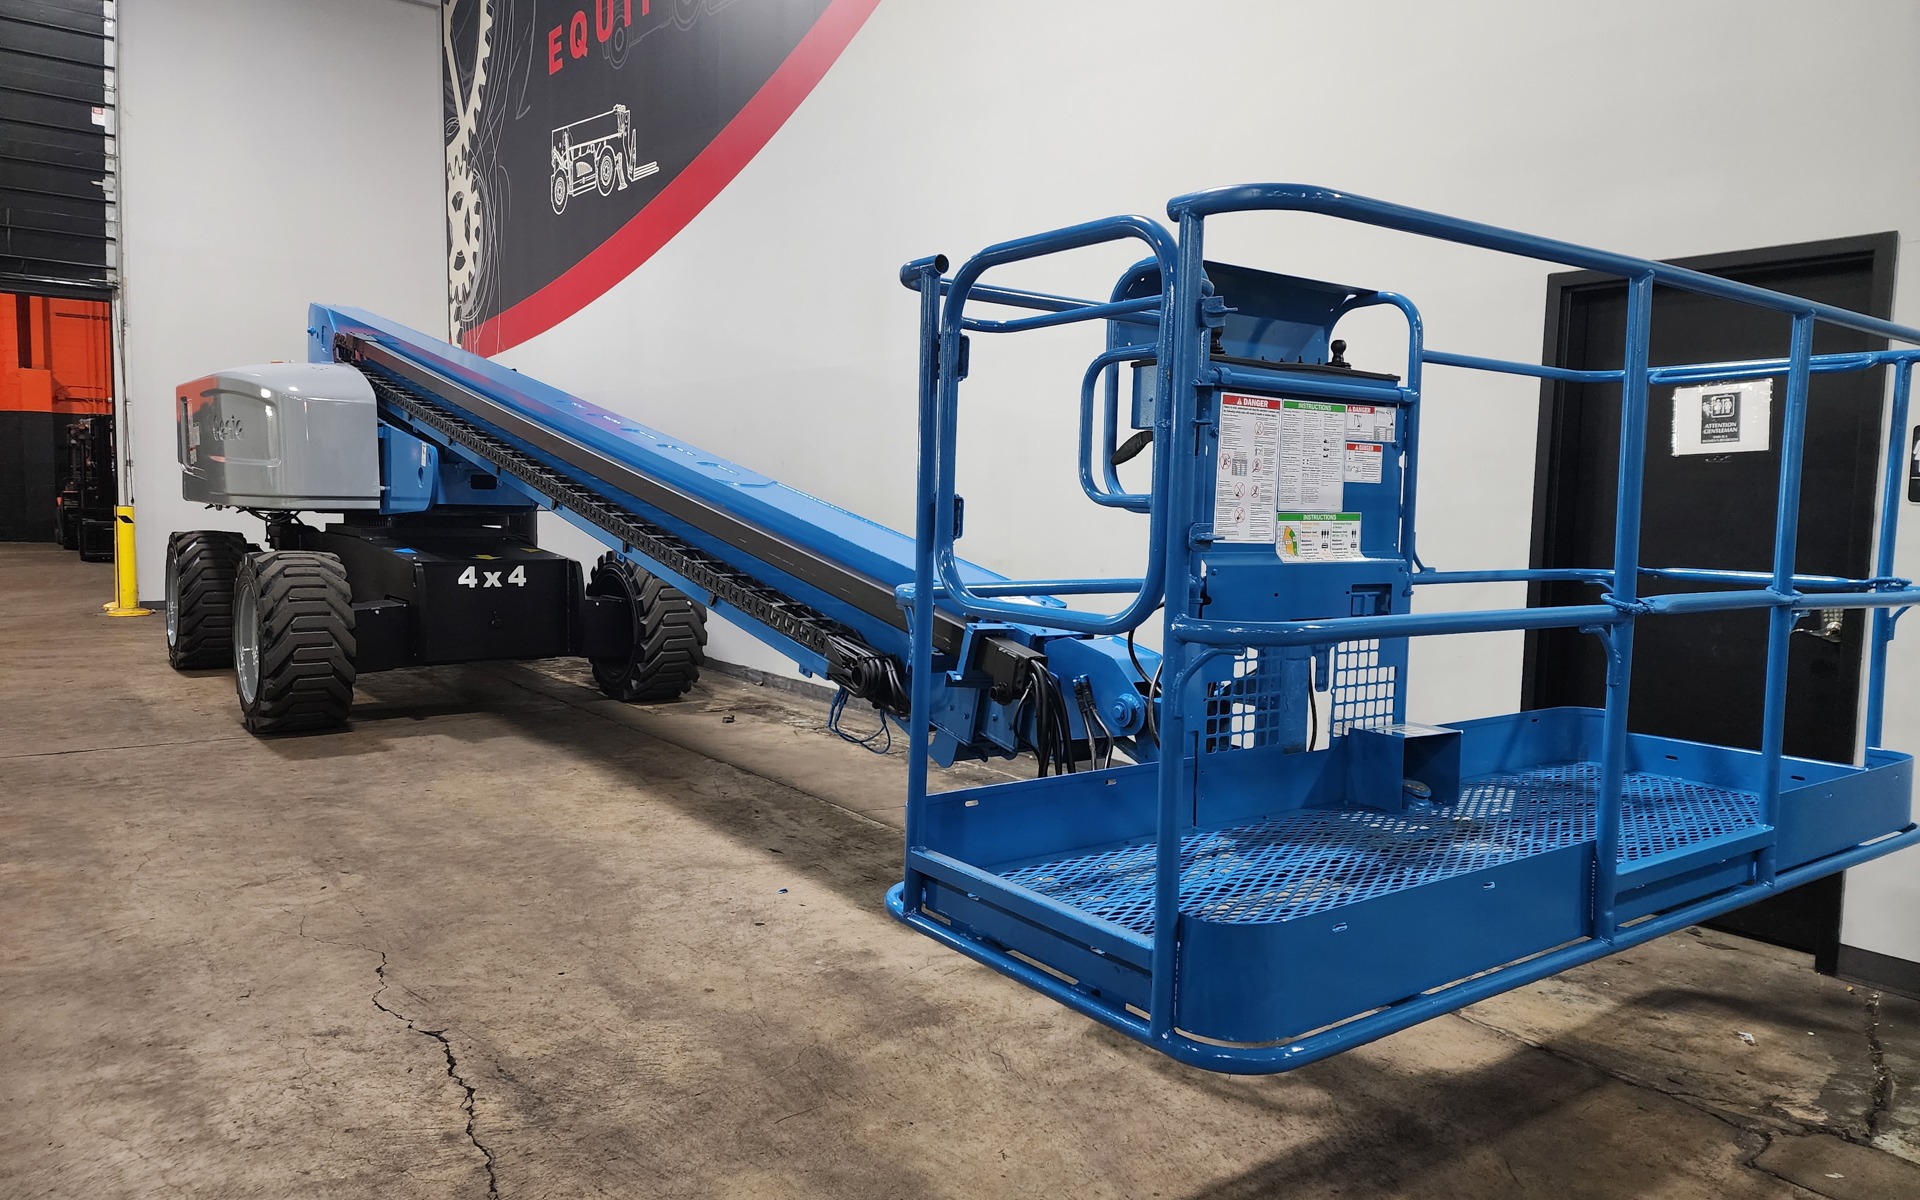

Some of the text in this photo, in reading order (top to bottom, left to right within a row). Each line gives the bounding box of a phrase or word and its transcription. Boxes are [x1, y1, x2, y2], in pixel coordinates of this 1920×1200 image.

[1243, 397, 1268, 408] DANGER
[1298, 402, 1332, 411] INSTRUCTIONS
[458, 565, 527, 588] 4 x 4
